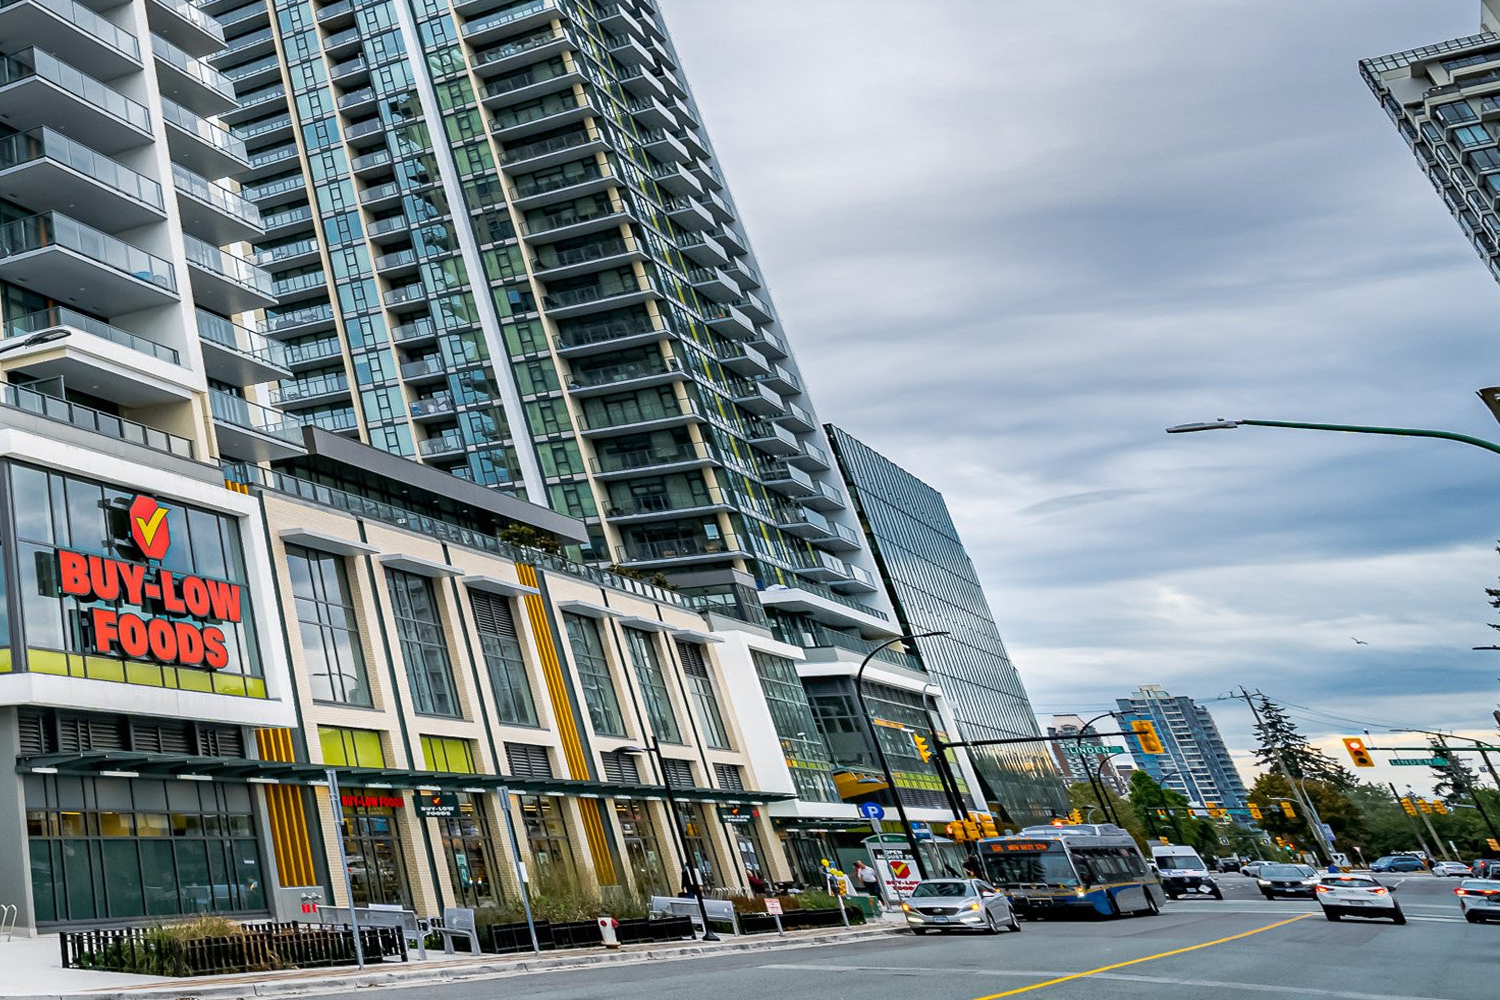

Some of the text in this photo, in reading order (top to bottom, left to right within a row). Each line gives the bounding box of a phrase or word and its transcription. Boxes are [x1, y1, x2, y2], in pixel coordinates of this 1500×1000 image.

[58, 549, 242, 623] BUY-LOW
[92, 607, 229, 669] FOODS
[1069, 746, 1110, 754] LINDEN
